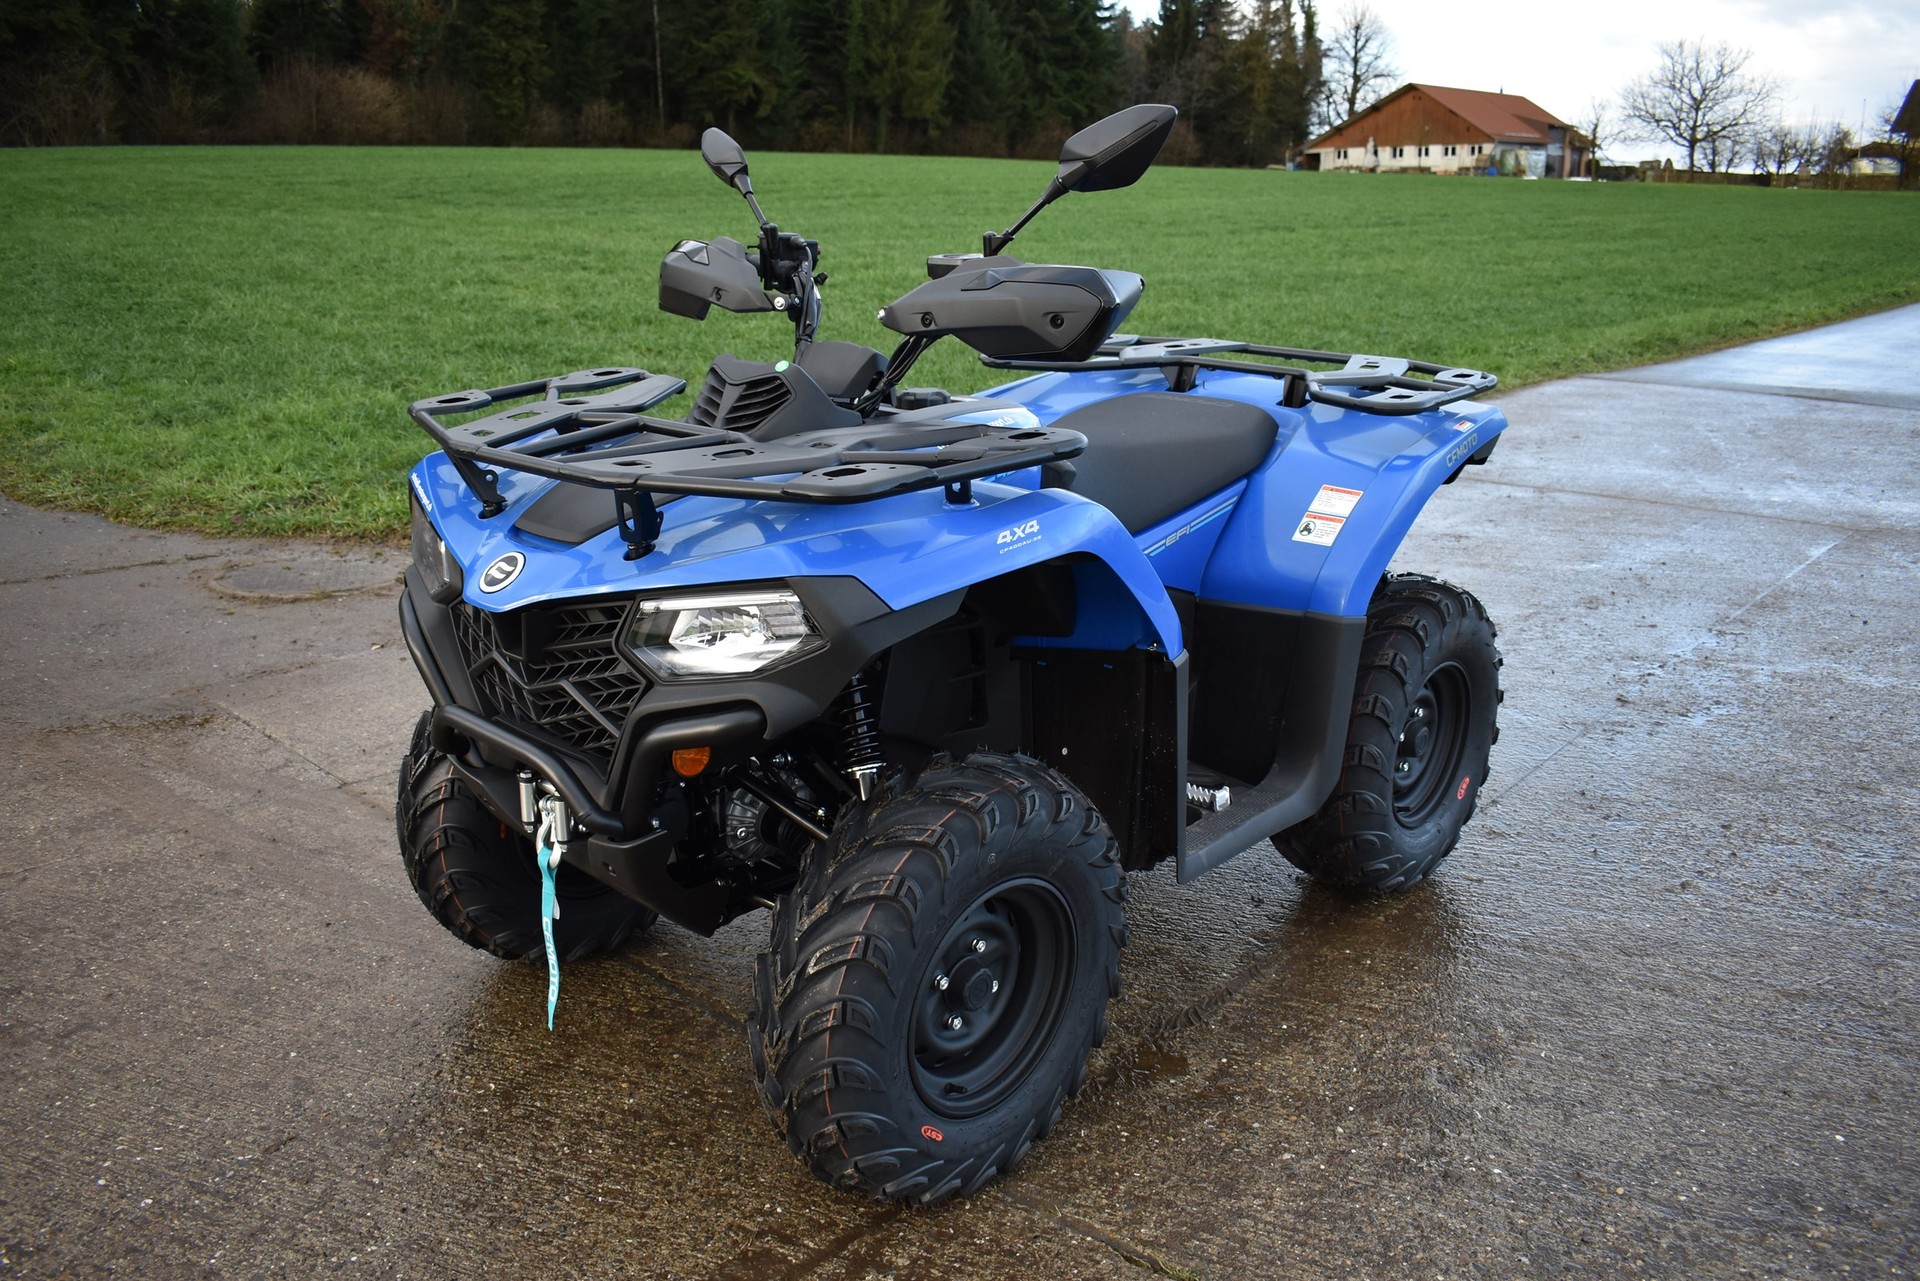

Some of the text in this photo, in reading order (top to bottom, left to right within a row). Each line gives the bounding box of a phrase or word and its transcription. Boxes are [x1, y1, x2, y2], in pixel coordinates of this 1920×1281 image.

[1446, 432, 1478, 468] CFMOTO
[996, 519, 1040, 545] 4X4
[1165, 524, 1190, 547] EFI
[542, 917, 558, 1002] CFMOTO
[922, 1126, 944, 1142] CST
